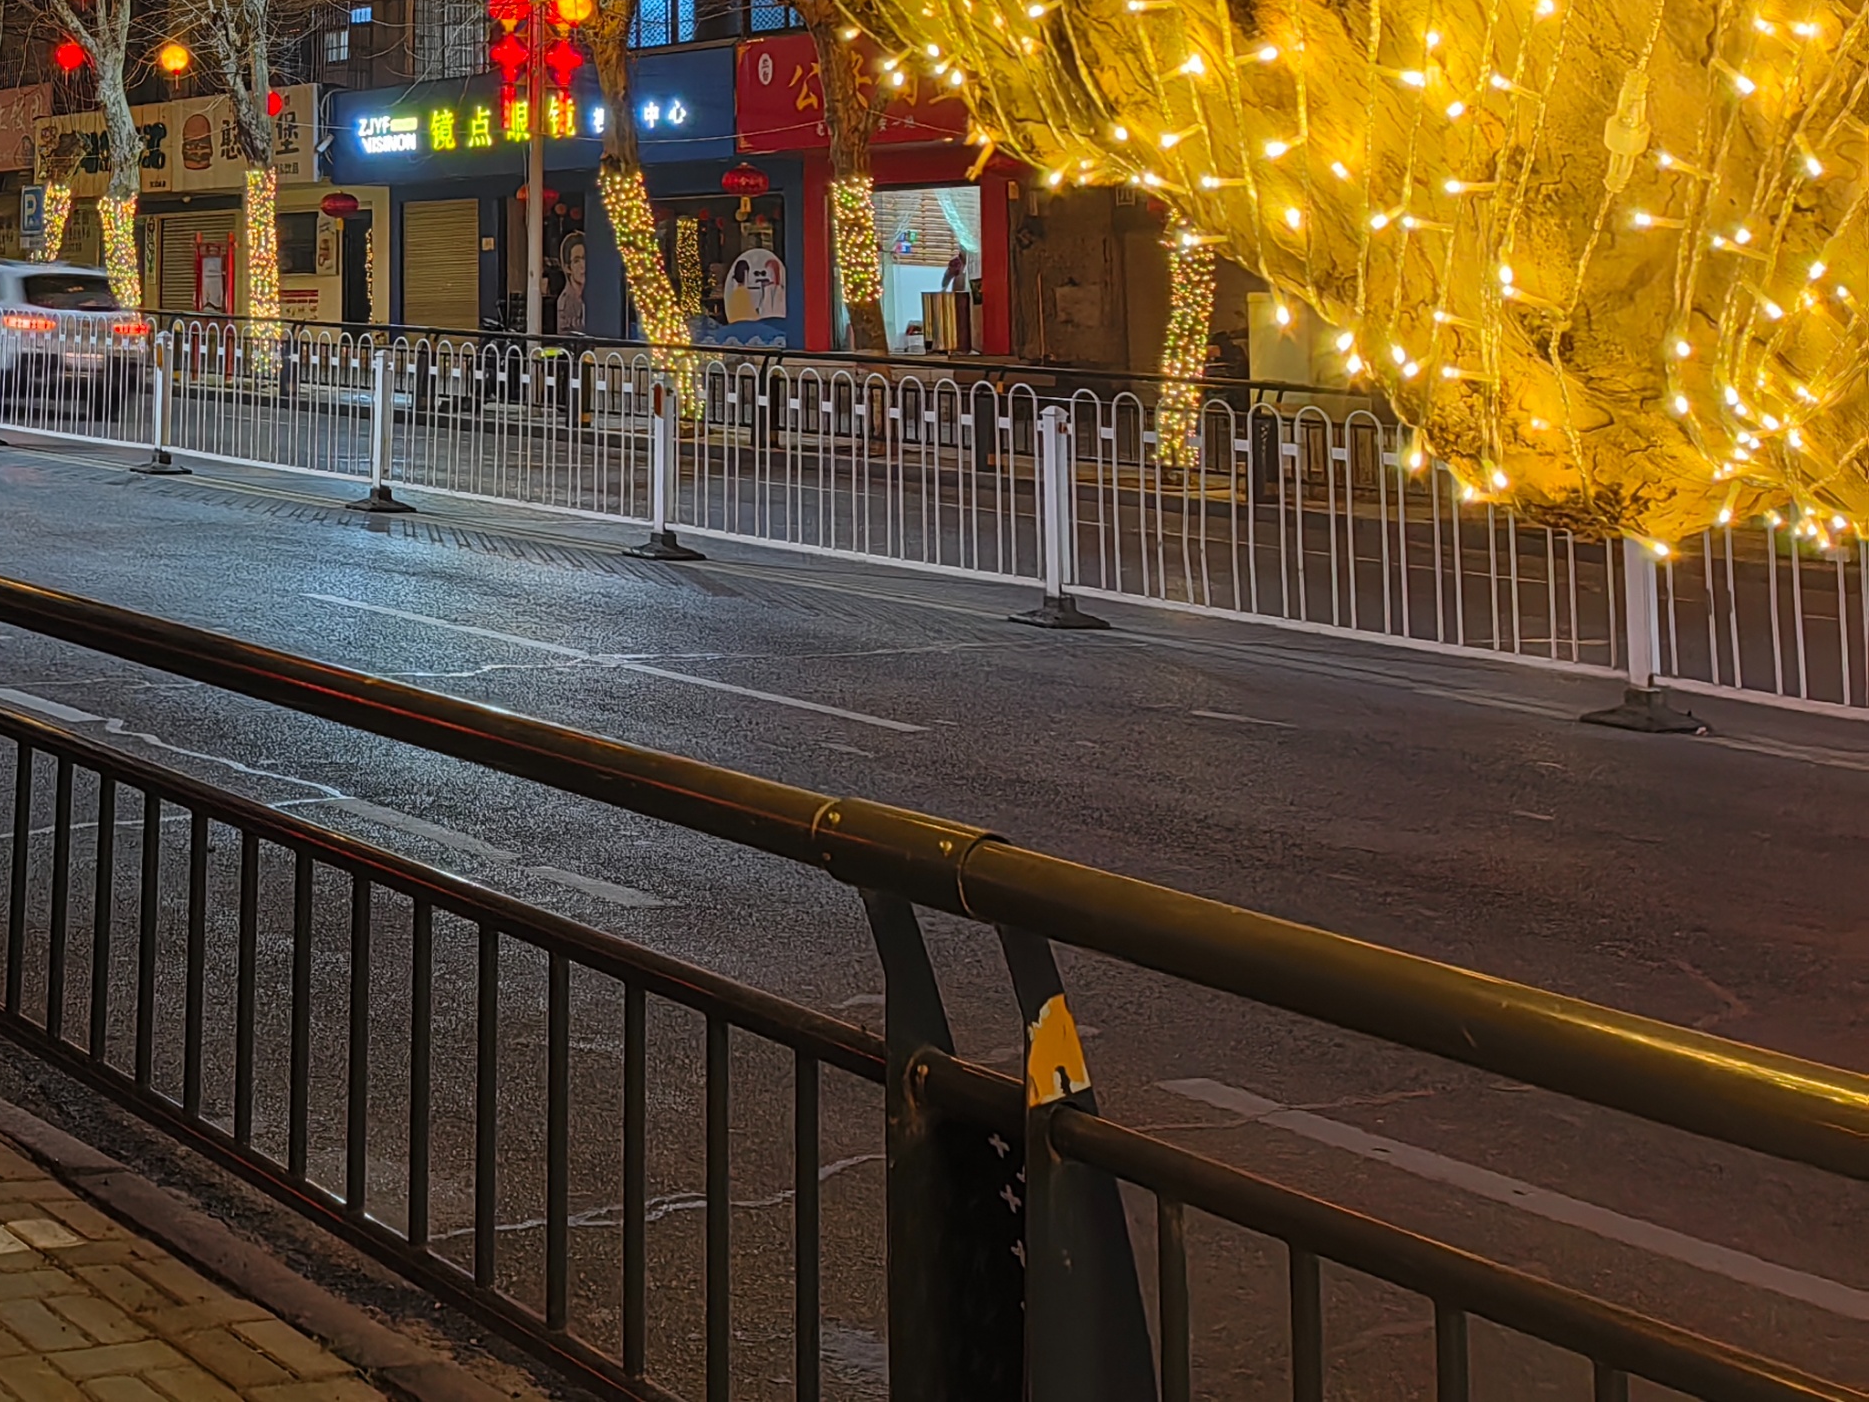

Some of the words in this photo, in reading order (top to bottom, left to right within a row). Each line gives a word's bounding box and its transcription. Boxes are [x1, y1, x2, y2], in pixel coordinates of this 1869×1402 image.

[430, 96, 576, 151] 镜点眼镜
[24, 193, 38, 229] P
